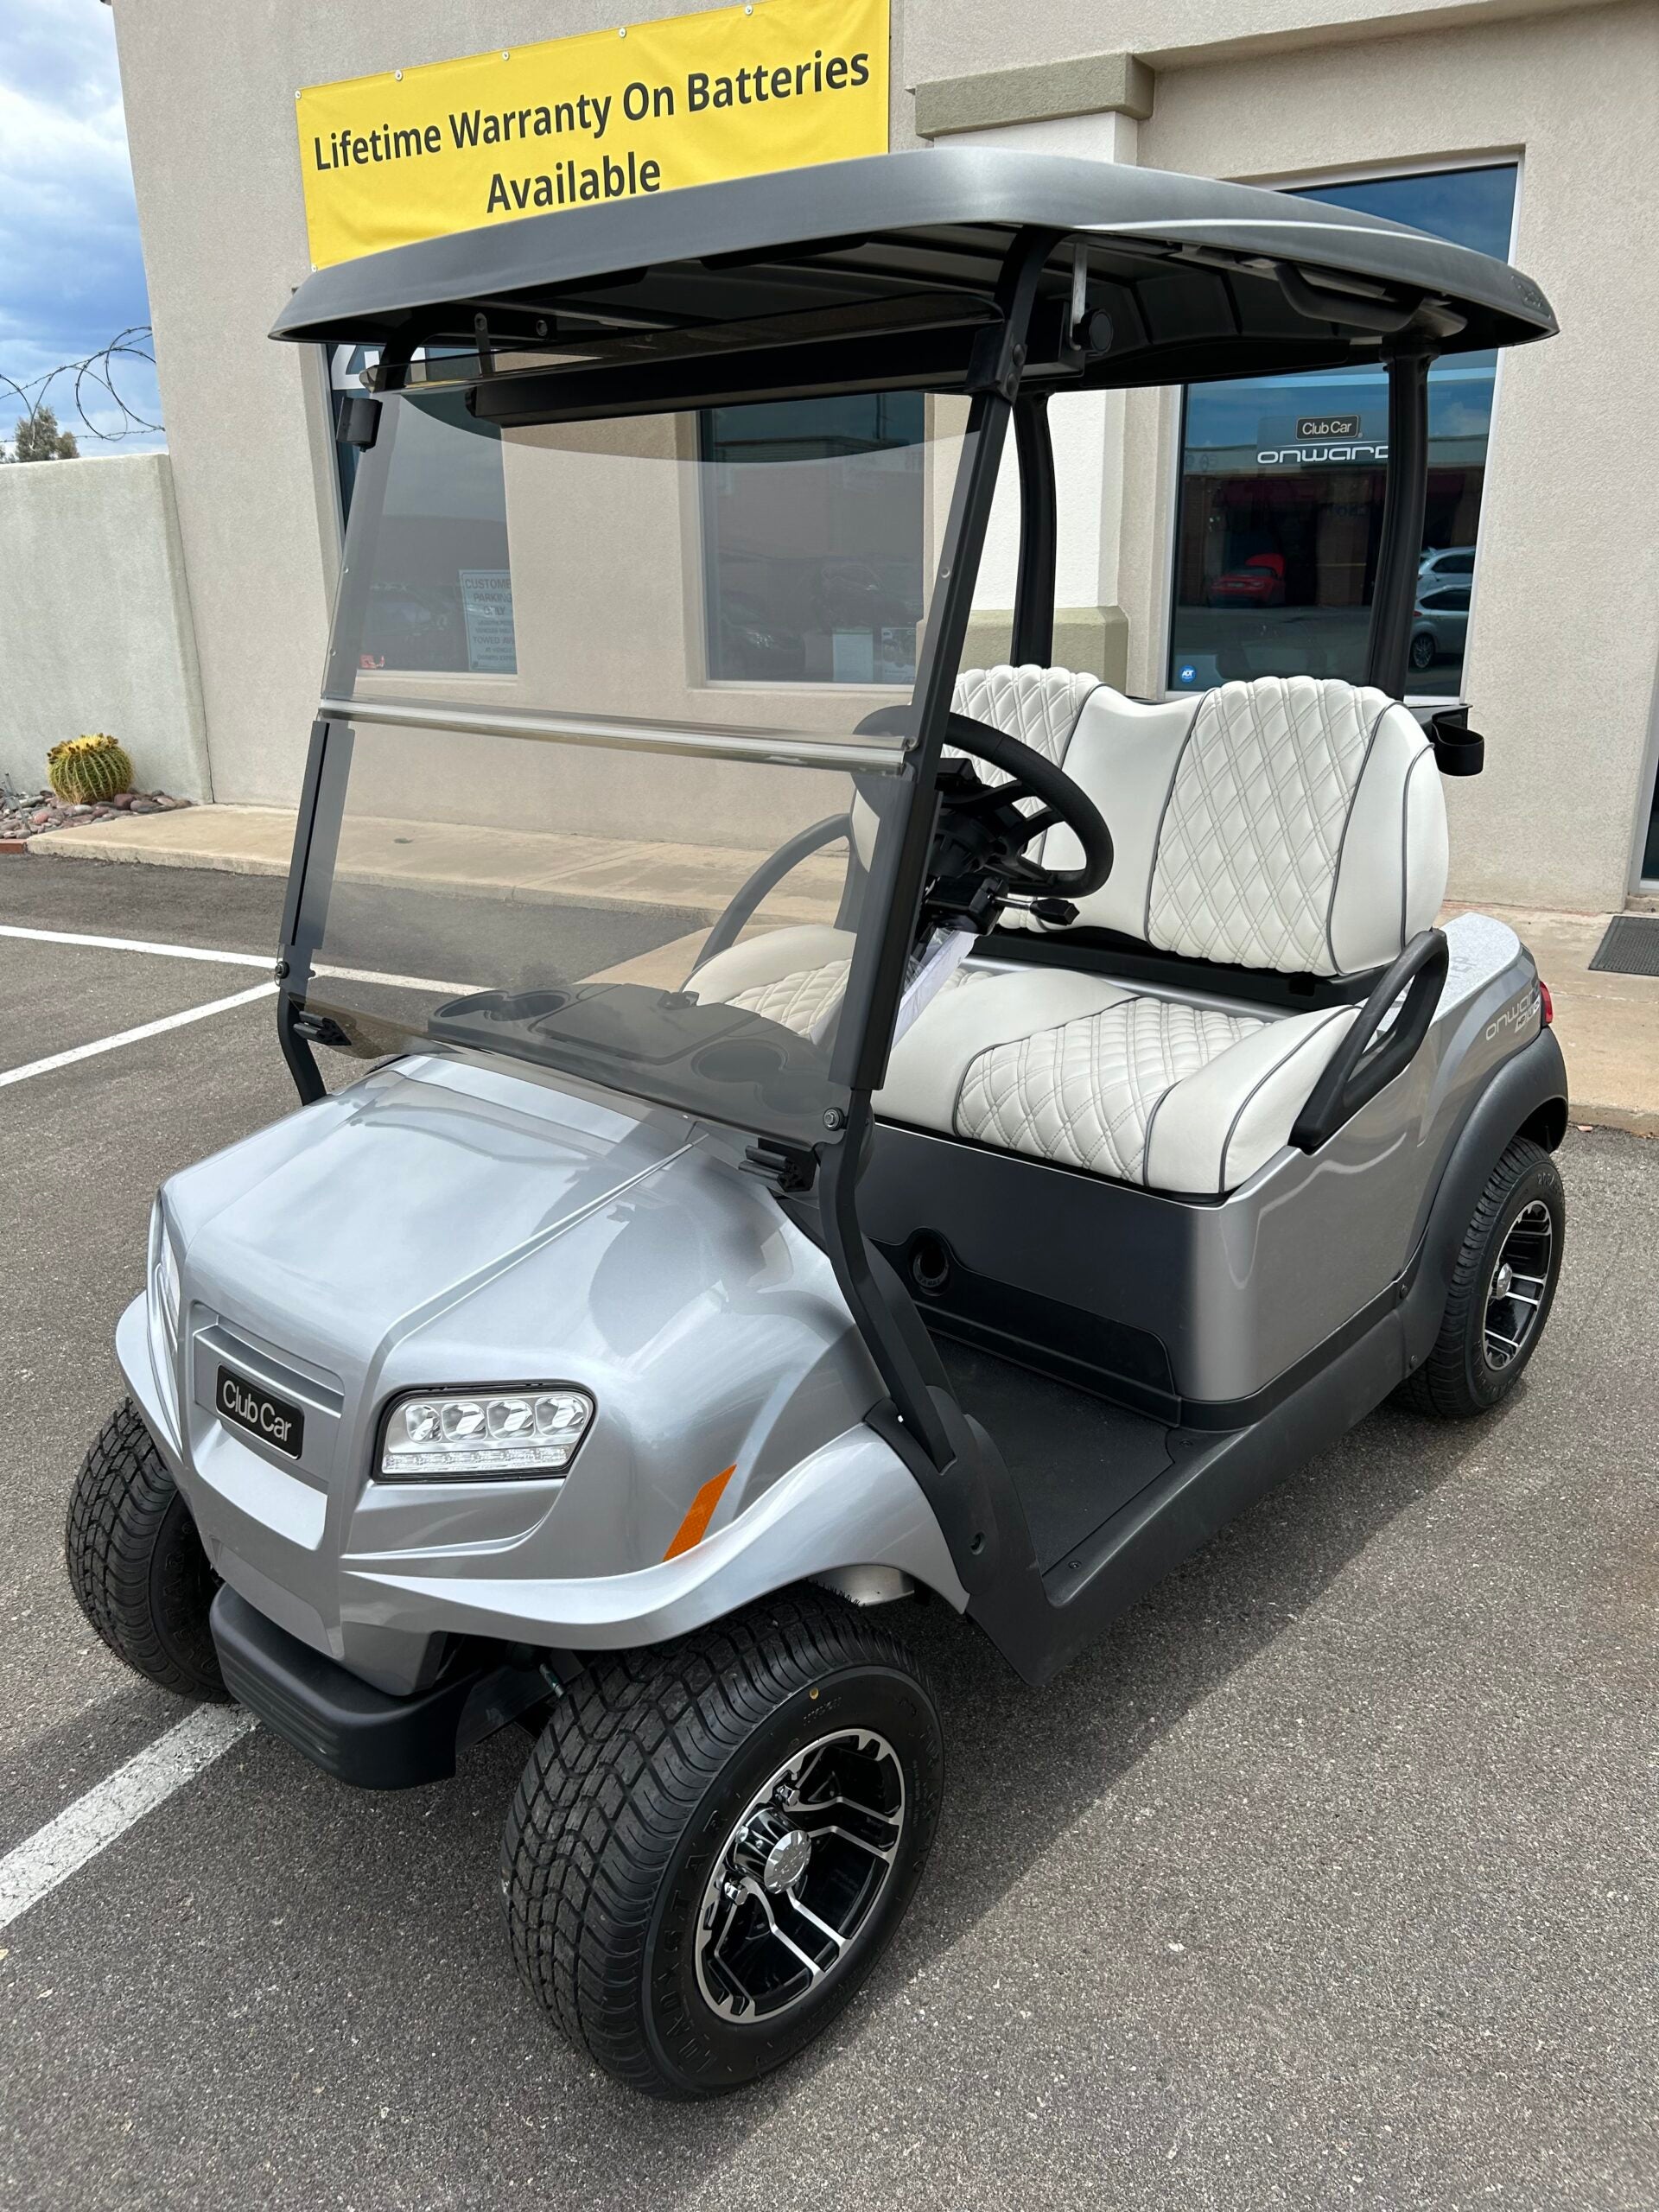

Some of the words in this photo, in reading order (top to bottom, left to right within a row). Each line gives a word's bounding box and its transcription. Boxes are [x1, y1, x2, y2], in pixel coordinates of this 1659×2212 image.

[314, 122, 442, 171] Lifetime
[448, 92, 612, 149] Warranty
[622, 81, 676, 123] On
[688, 48, 870, 113] Batteries
[486, 151, 662, 214] Available
[1301, 422, 1330, 435] Club
[1330, 420, 1352, 434] Car
[465, 578, 512, 589] CUSTOME
[222, 1379, 259, 1424] Club
[259, 1402, 293, 1442] Car
